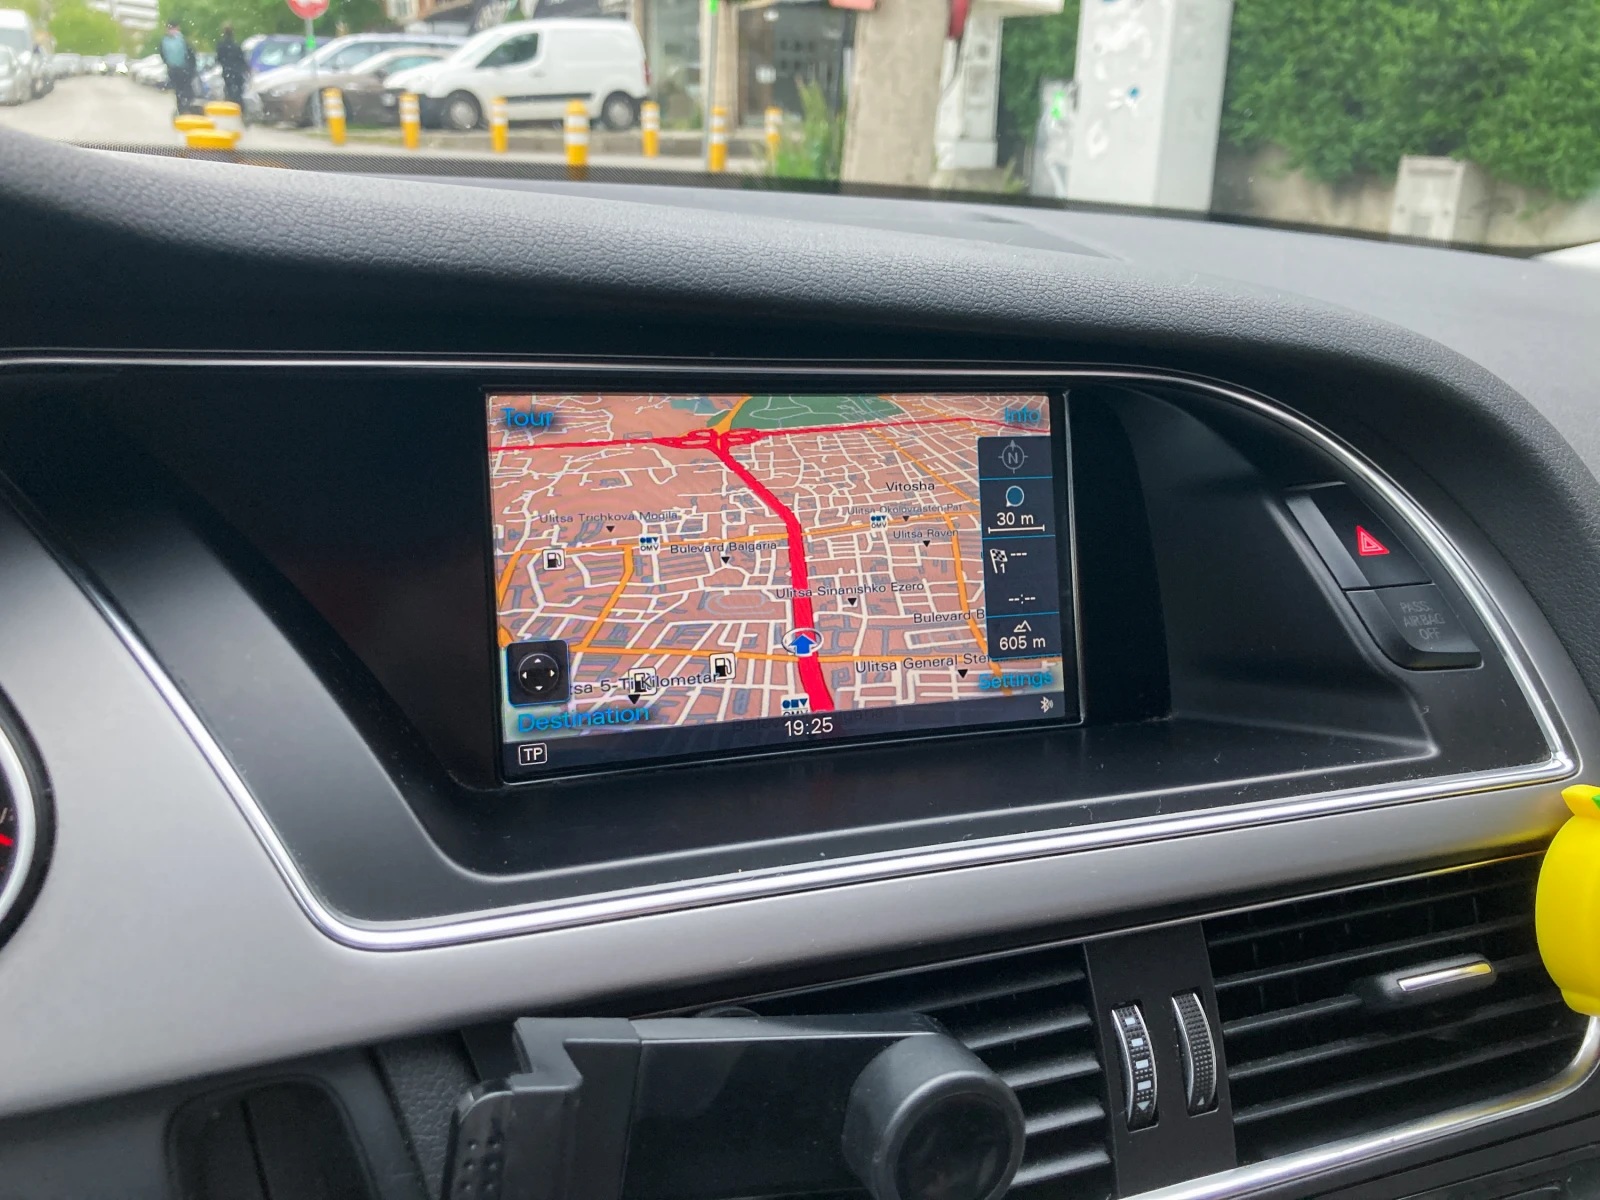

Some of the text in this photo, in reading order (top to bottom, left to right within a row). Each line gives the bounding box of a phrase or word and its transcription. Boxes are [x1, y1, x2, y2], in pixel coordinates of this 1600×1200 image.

[503, 407, 554, 427] Tour
[1004, 405, 1041, 423] Info
[885, 480, 935, 493] Vitosha
[539, 511, 678, 524] Ulitsa Trichkova Mogila
[847, 506, 875, 515] Ulitsa
[996, 512, 1034, 526] 30 m
[893, 528, 959, 539] Ulitsa Raven
[670, 541, 777, 555] Bulevard Balgaria
[776, 581, 925, 599] Ulitsa Sinanishko Ezero
[913, 611, 971, 624] Bulevard
[1418, 627, 1440, 640] OFF
[999, 635, 1046, 650] 605 m
[856, 652, 990, 674] Ulitsa General Ste
[640, 672, 720, 690] Kilometar
[978, 671, 1054, 690] Settings
[517, 706, 650, 733] Destination
[784, 716, 834, 737] 19:25
[523, 746, 544, 761] TP
